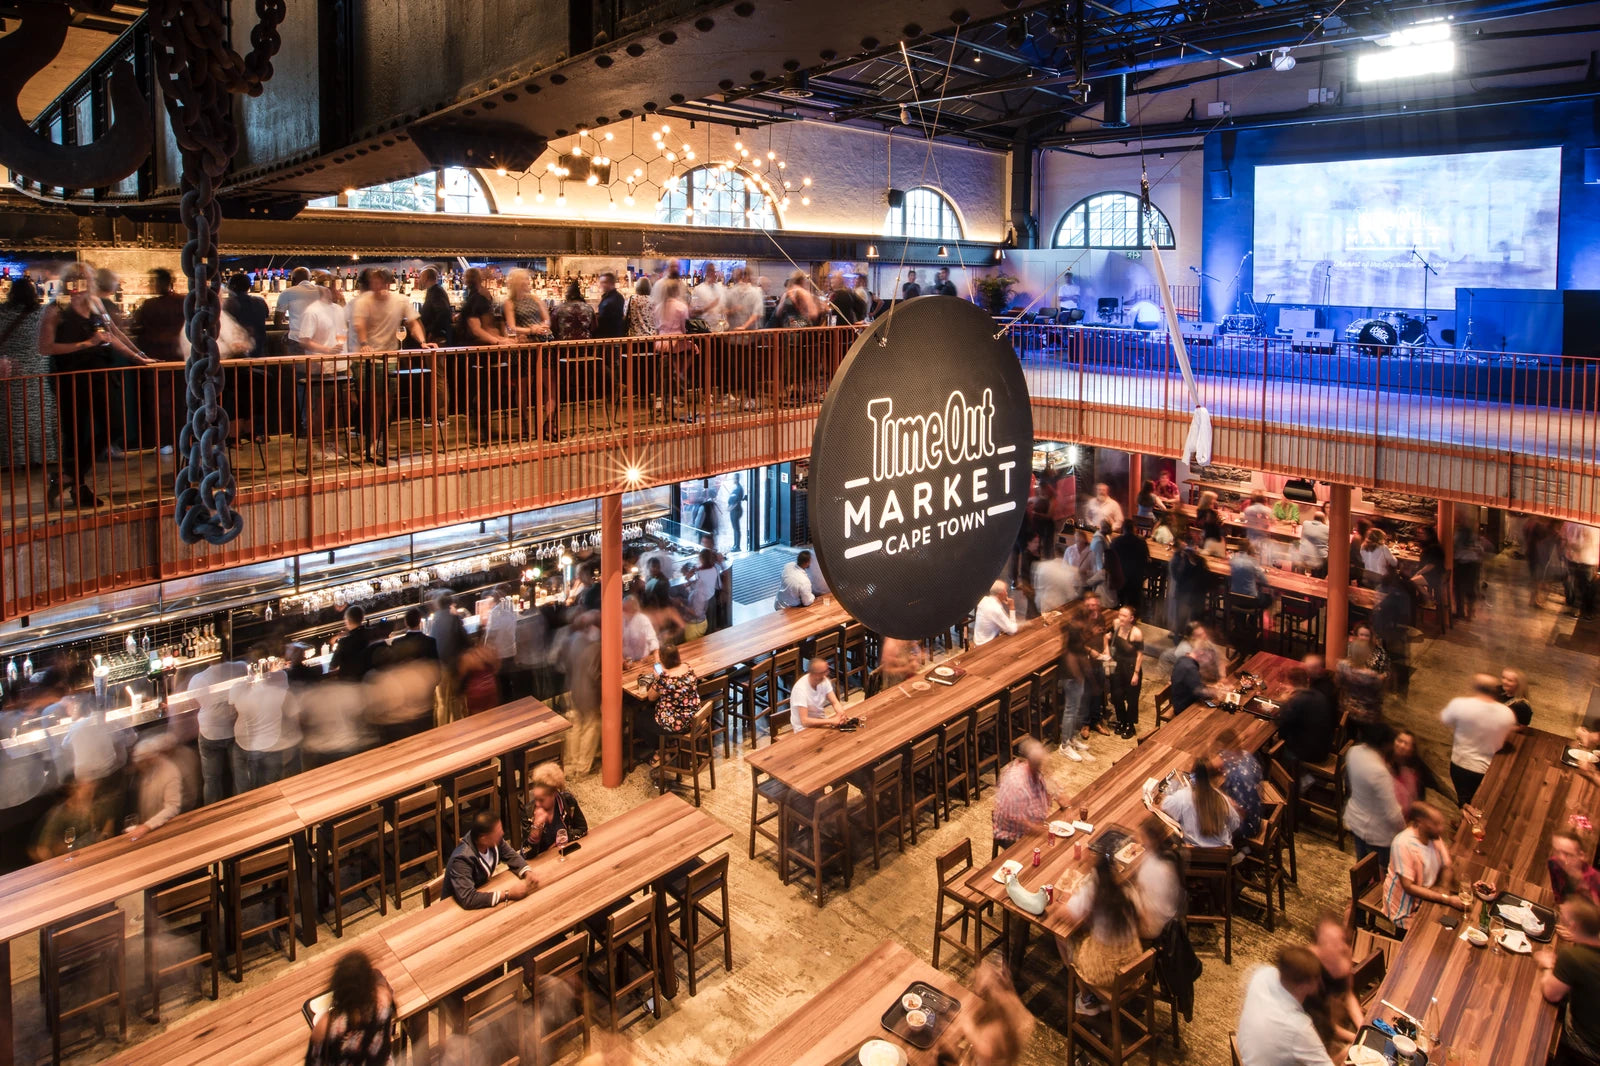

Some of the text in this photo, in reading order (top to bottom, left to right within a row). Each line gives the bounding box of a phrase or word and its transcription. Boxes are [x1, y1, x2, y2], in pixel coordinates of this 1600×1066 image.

[868, 388, 995, 482] Time Out
[844, 461, 1016, 538] MARKET
[886, 509, 986, 554] CAPE TOWN
